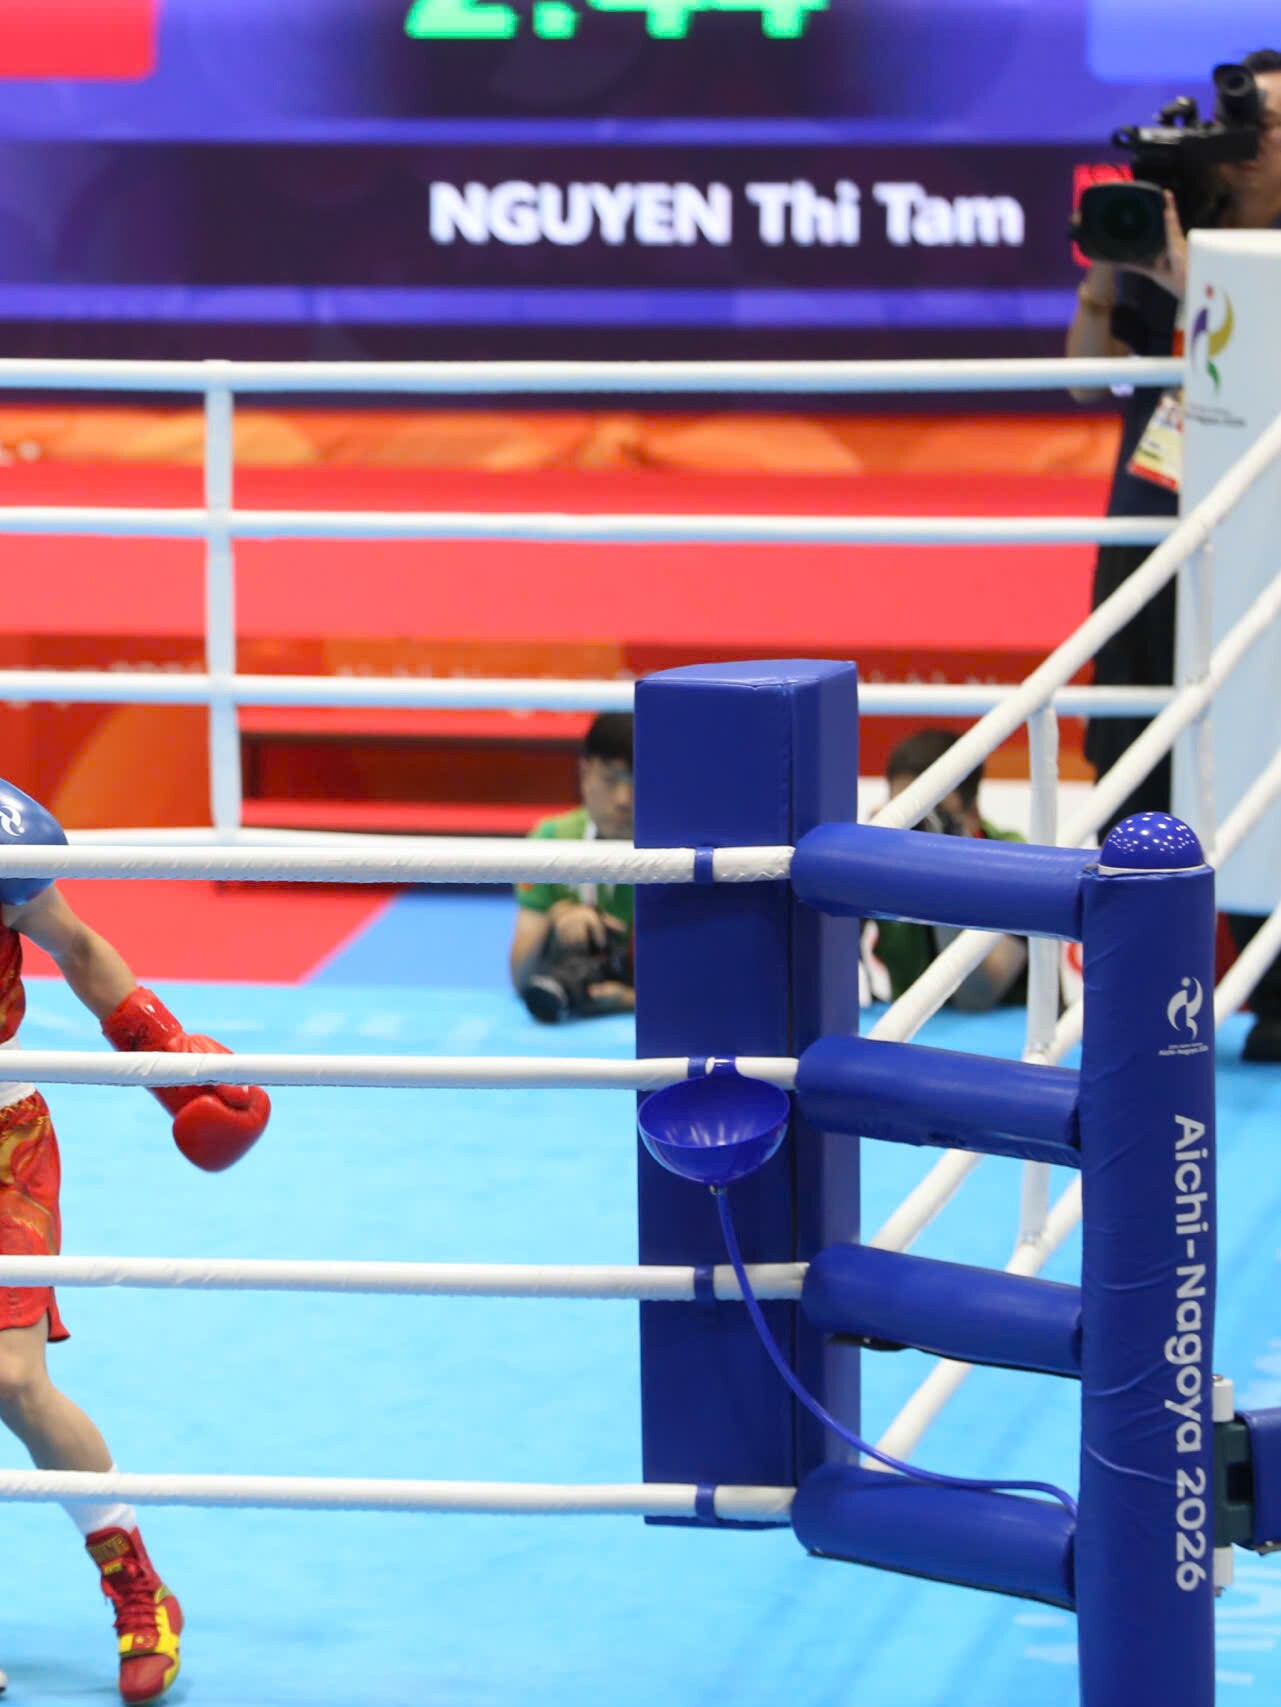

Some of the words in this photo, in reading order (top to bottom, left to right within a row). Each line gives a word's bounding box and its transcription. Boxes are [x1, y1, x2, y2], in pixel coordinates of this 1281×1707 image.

[429, 181, 732, 246] NGUYEN
[745, 180, 860, 246] Thi
[873, 182, 1025, 247] Tam
[1164, 1114, 1209, 1453] Aichi-Nagoya
[1175, 1467, 1207, 1592] 2026
